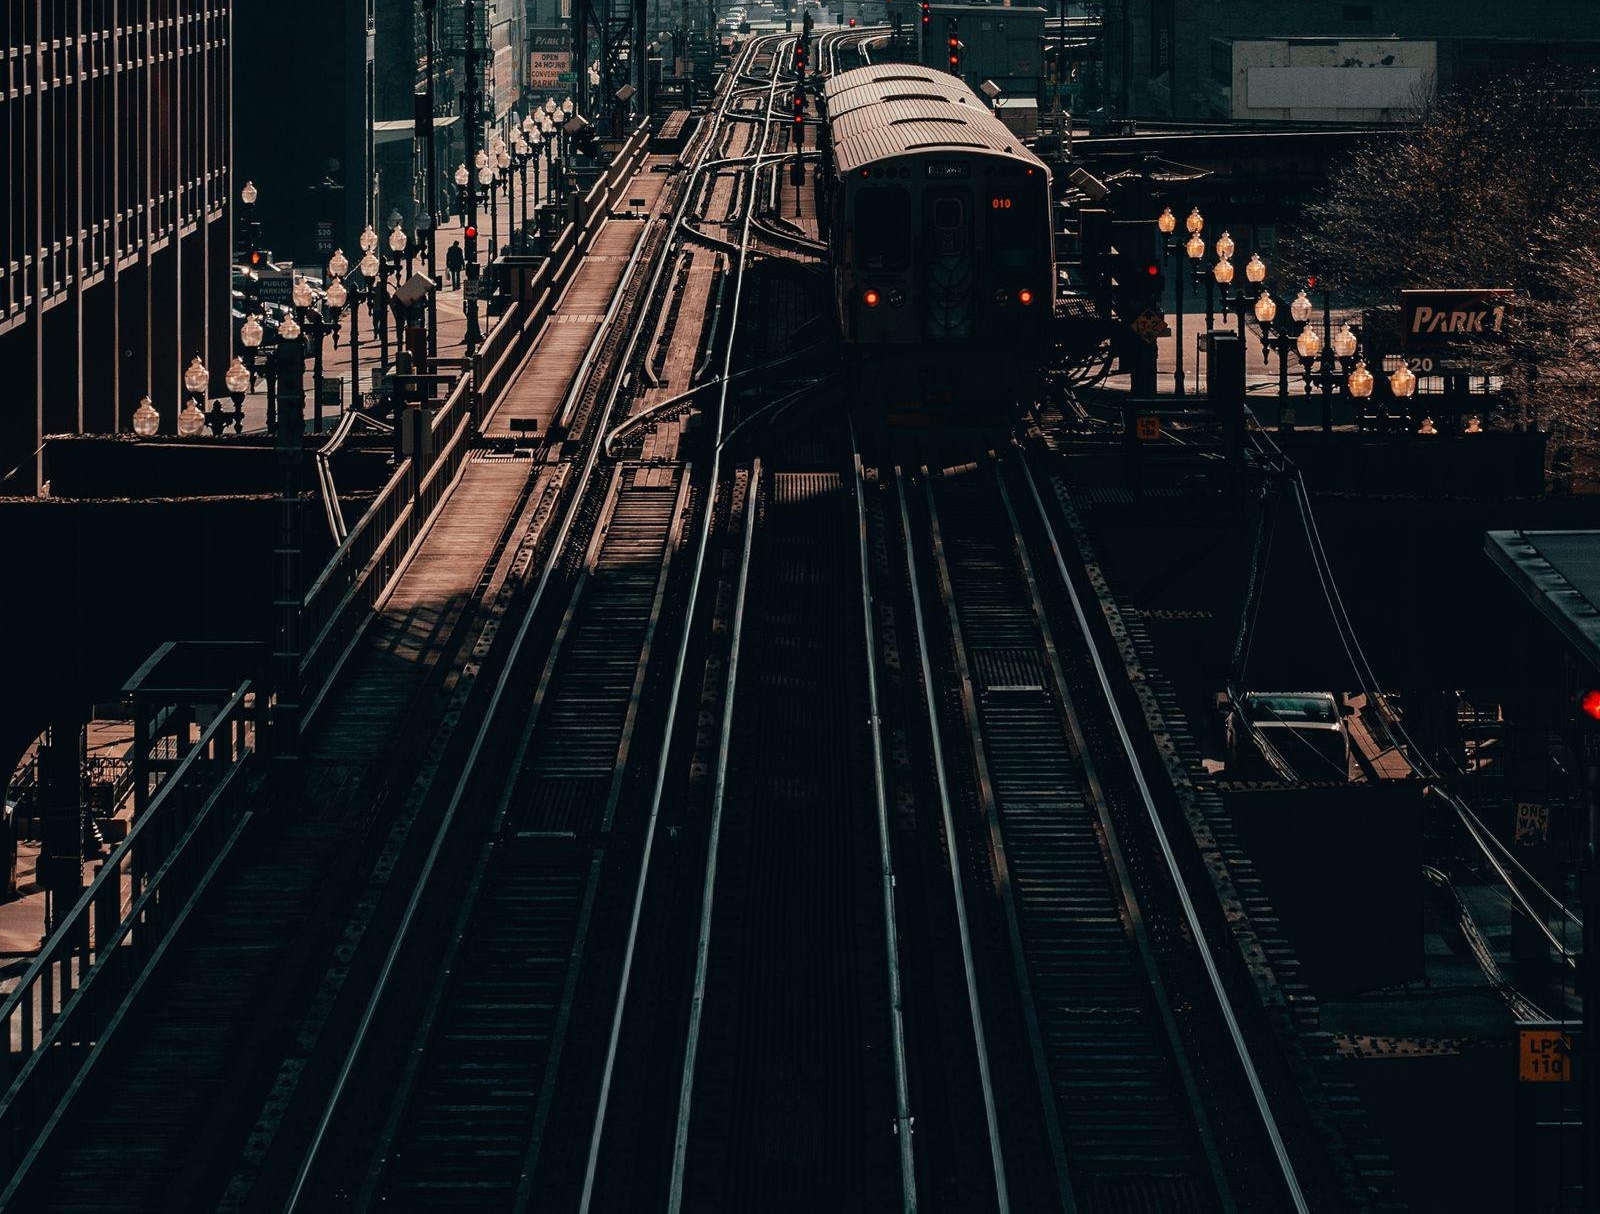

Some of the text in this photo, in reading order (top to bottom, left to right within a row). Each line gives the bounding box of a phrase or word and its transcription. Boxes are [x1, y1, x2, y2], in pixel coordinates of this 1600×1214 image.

[541, 53, 559, 61] OPEN
[543, 61, 566, 69] HOURS
[992, 198, 1011, 209] 010
[1412, 304, 1506, 333] PARK 1
[1520, 804, 1547, 818] ONE
[1519, 818, 1546, 831] WAY
[1531, 1059, 1562, 1074] 110
